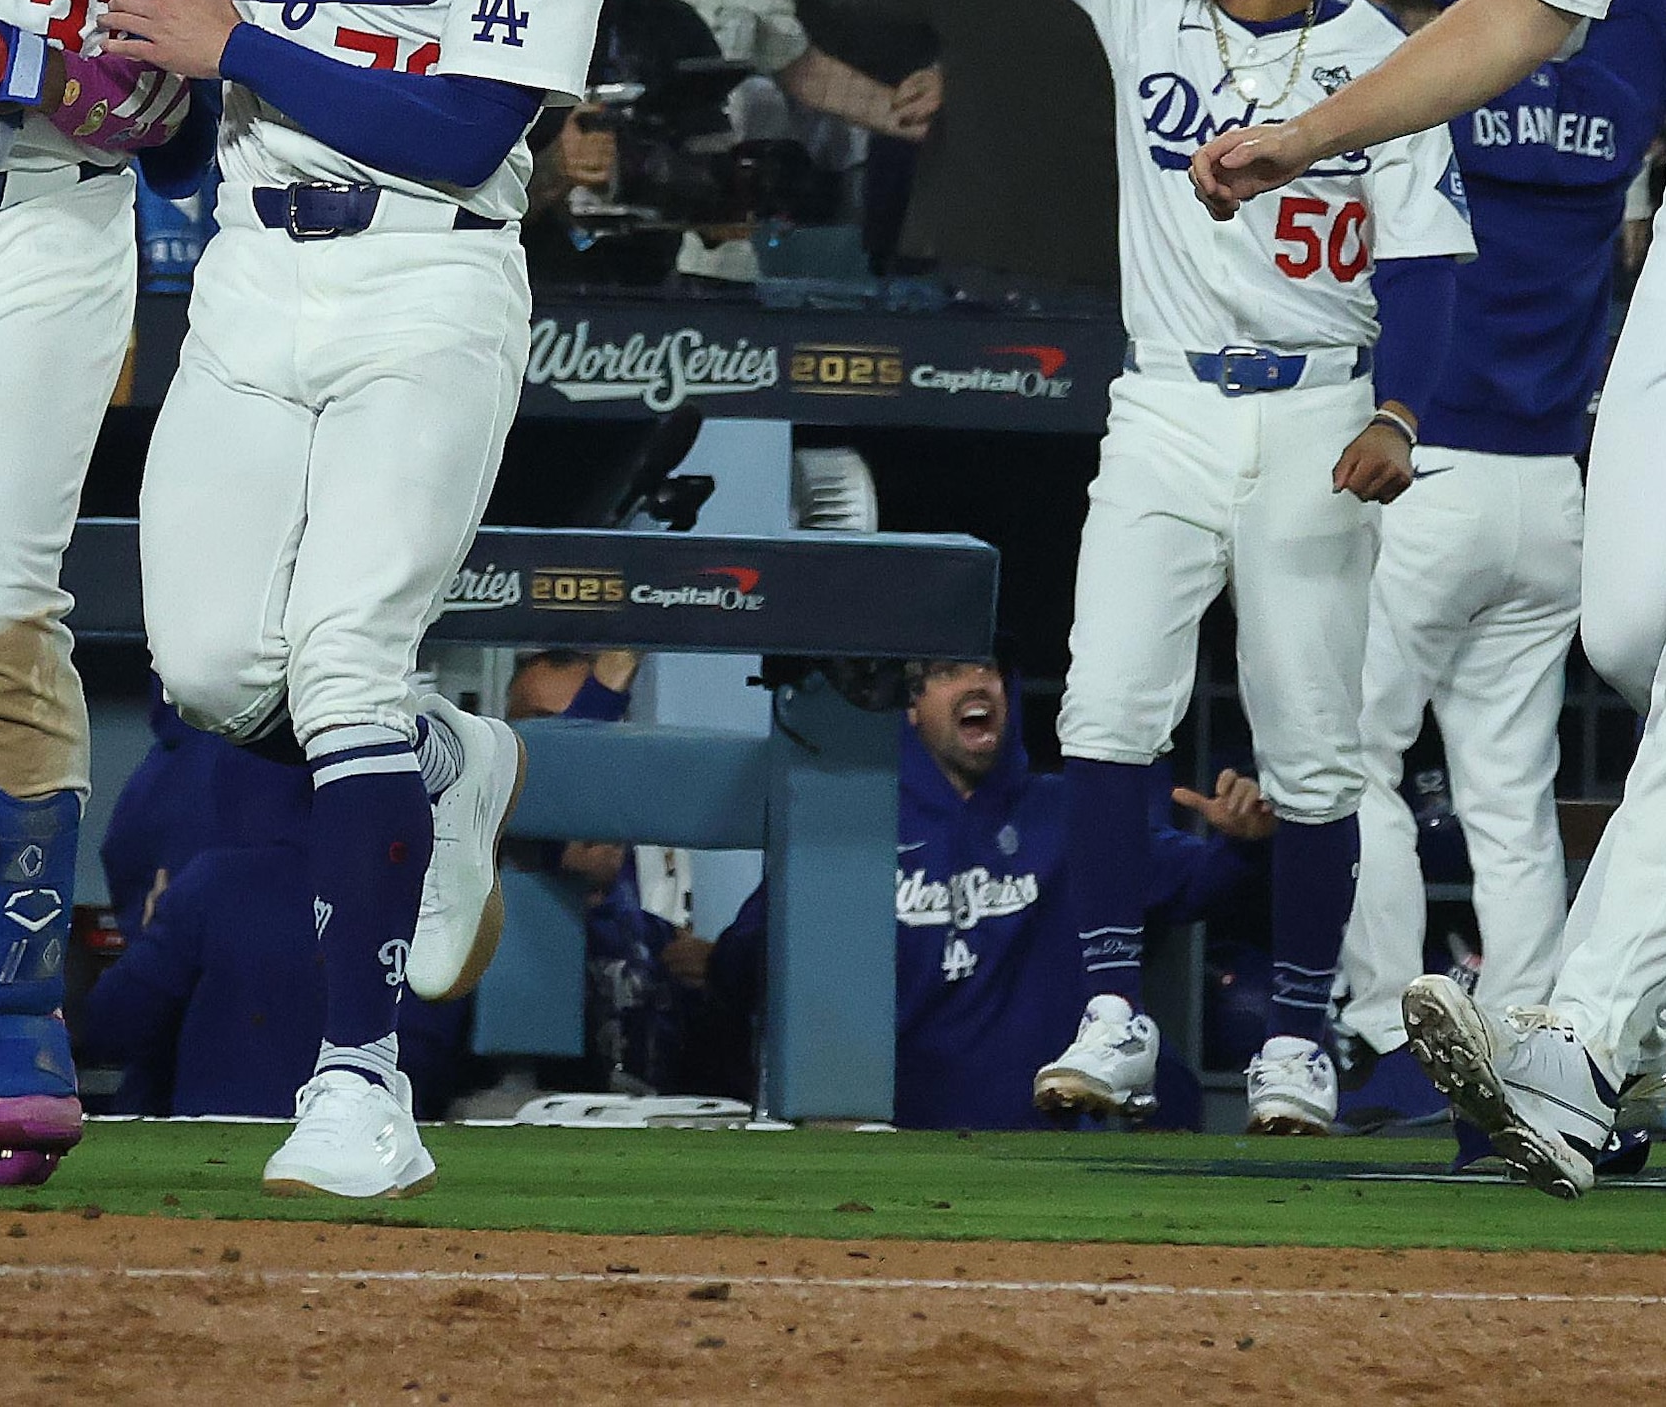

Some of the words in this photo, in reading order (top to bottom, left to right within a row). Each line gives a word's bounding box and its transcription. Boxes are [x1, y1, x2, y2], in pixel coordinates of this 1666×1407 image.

[1275, 196, 1370, 283] 50
[789, 354, 902, 383] 2025
[443, 563, 523, 605] eries
[531, 578, 625, 602] 2025
